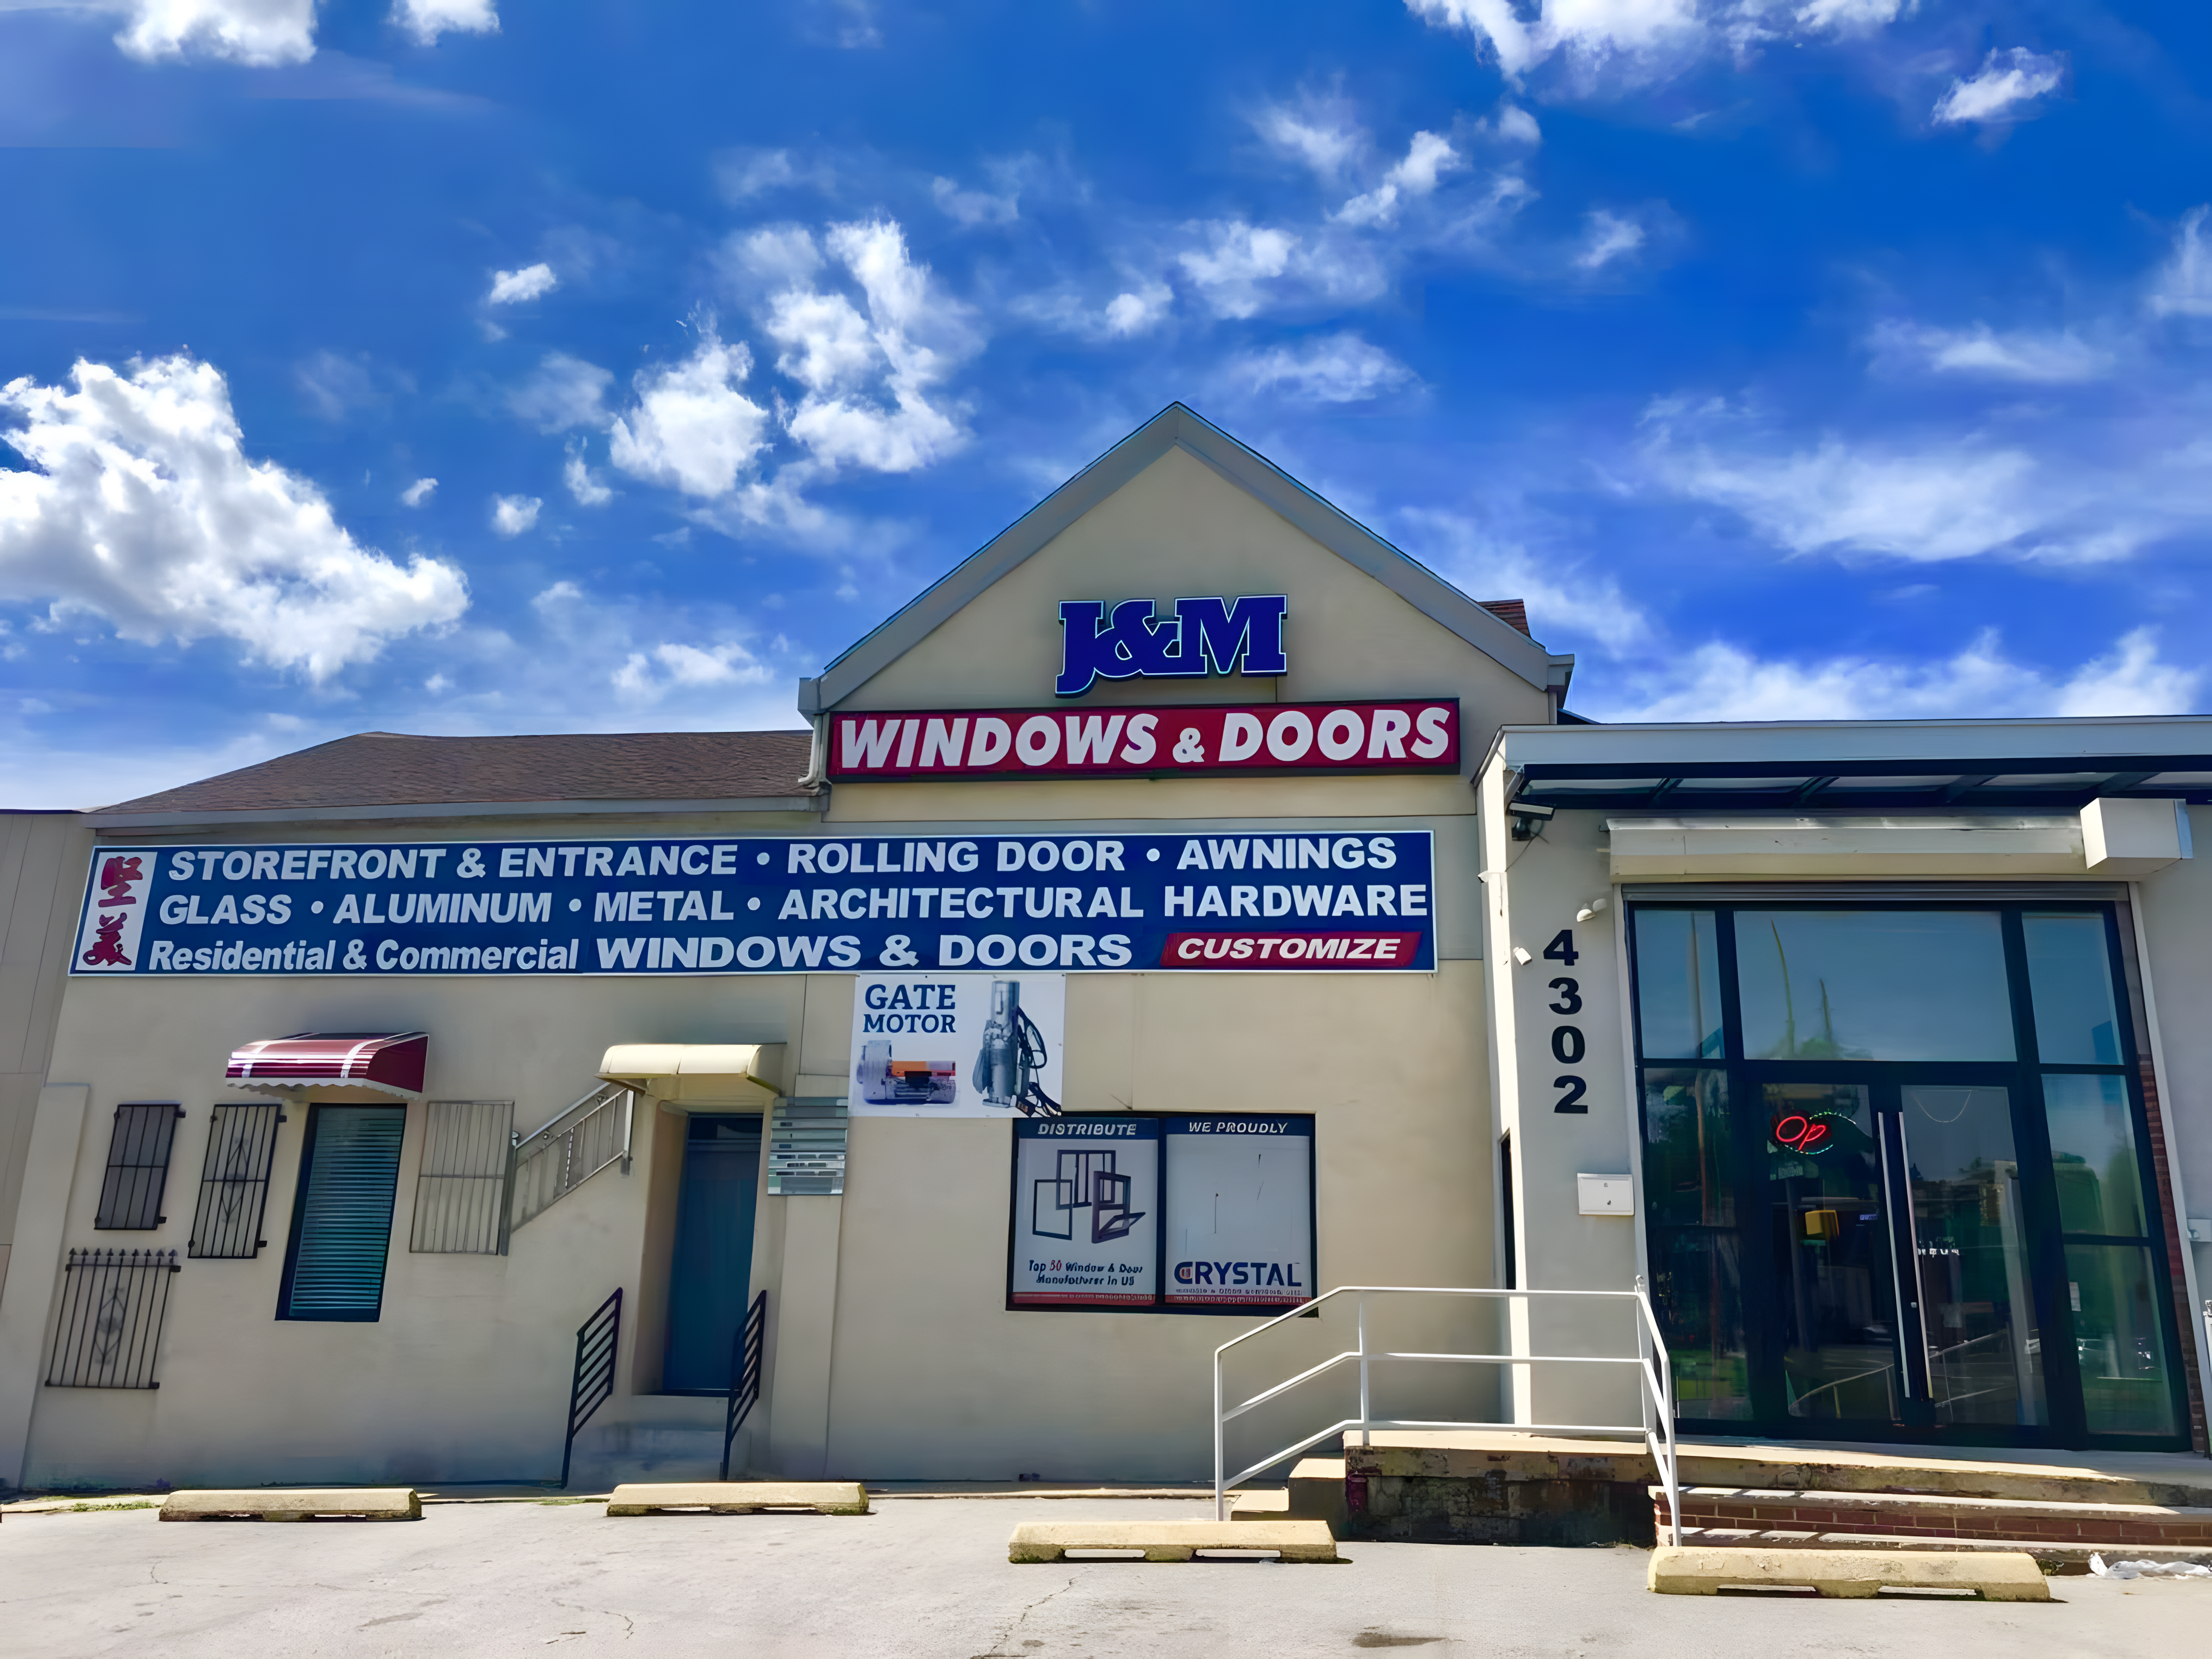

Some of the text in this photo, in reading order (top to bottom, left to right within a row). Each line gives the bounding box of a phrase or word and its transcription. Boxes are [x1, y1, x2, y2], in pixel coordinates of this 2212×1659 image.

[1055, 593, 1288, 698] J&M
[842, 708, 1450, 768] WINDOWS & DOORS
[169, 838, 1396, 880] STOREFRONT & ENTRANCE ROLLING DOOR AWNINGS
[160, 885, 1427, 924] GLASS ALUMINUM METAL ARCHITECTURAL HARDWARE
[149, 934, 1132, 970] Residential & Commercial WINDOWS & DOORS
[1178, 939, 1400, 959] CUSTOMIZE
[865, 984, 955, 1009] GATE
[863, 1014, 955, 1033] MOTOR
[1038, 1124, 1136, 1135] DISTRIBUTE
[1189, 1122, 1288, 1133] WE PROUDLY
[1029, 1260, 1046, 1277] Top
[1174, 1262, 1302, 1286] CRYSTAL
